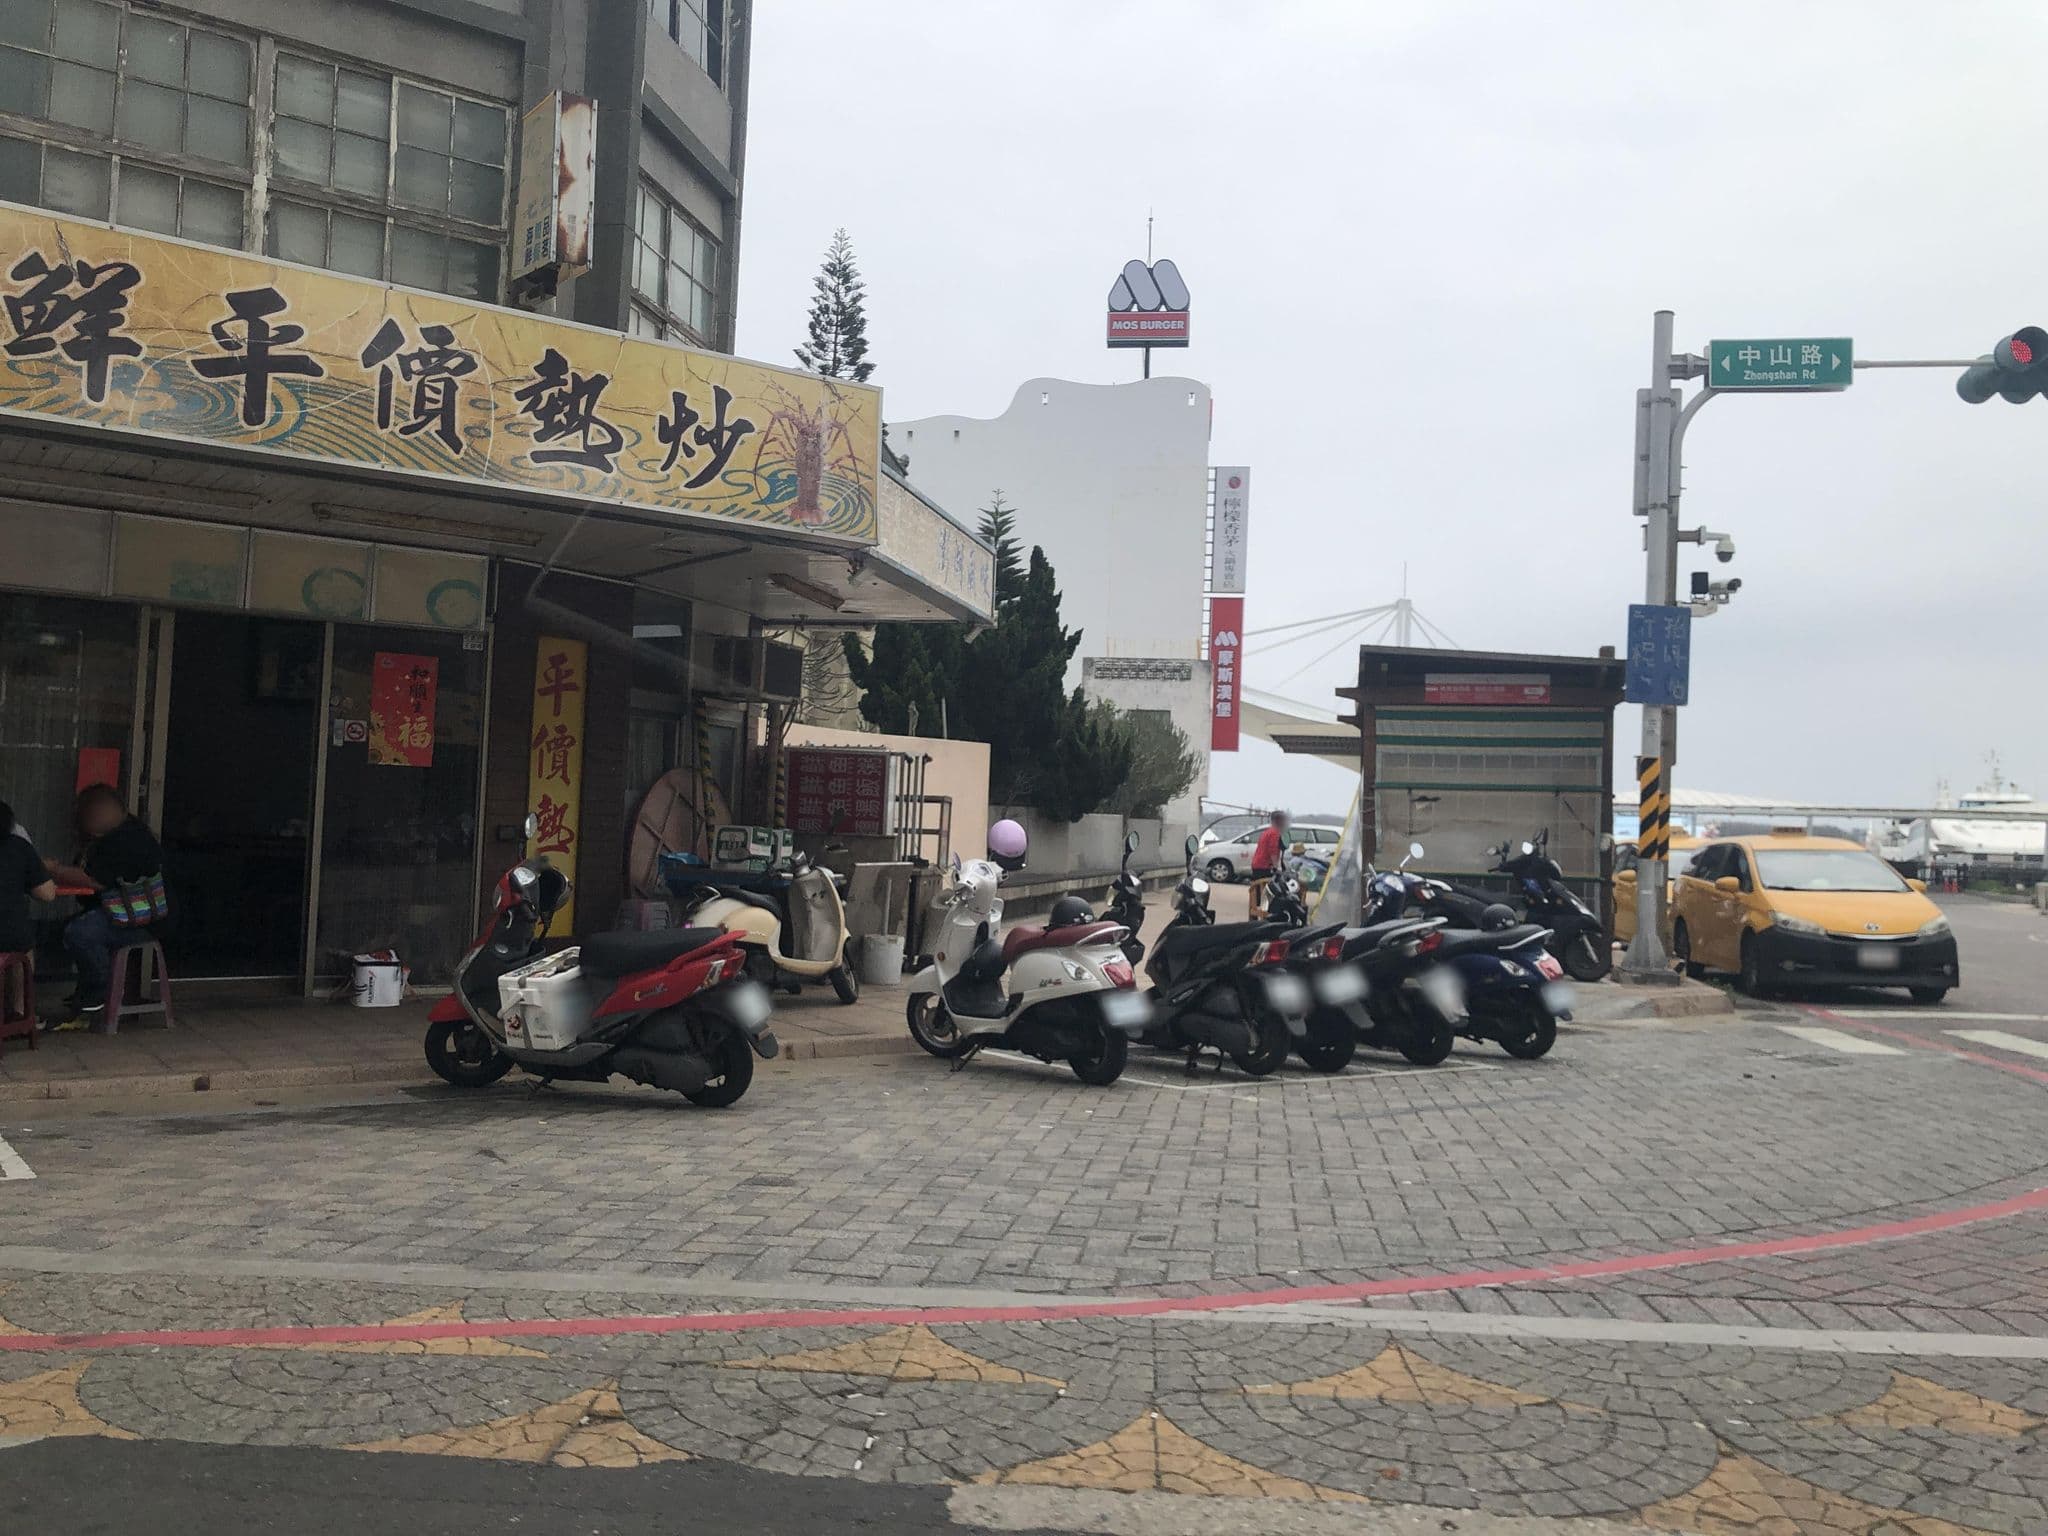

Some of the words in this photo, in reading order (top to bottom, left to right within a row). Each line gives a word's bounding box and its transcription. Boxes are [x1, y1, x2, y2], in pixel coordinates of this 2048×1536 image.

[1112, 320, 1139, 330] MOS
[1140, 320, 1185, 330] BURGER
[1738, 344, 1823, 366] 中山路
[1743, 370, 1798, 381] Zhongshan
[1215, 650, 1236, 718] 摩斯漢堡
[532, 652, 579, 928] 平價熱
